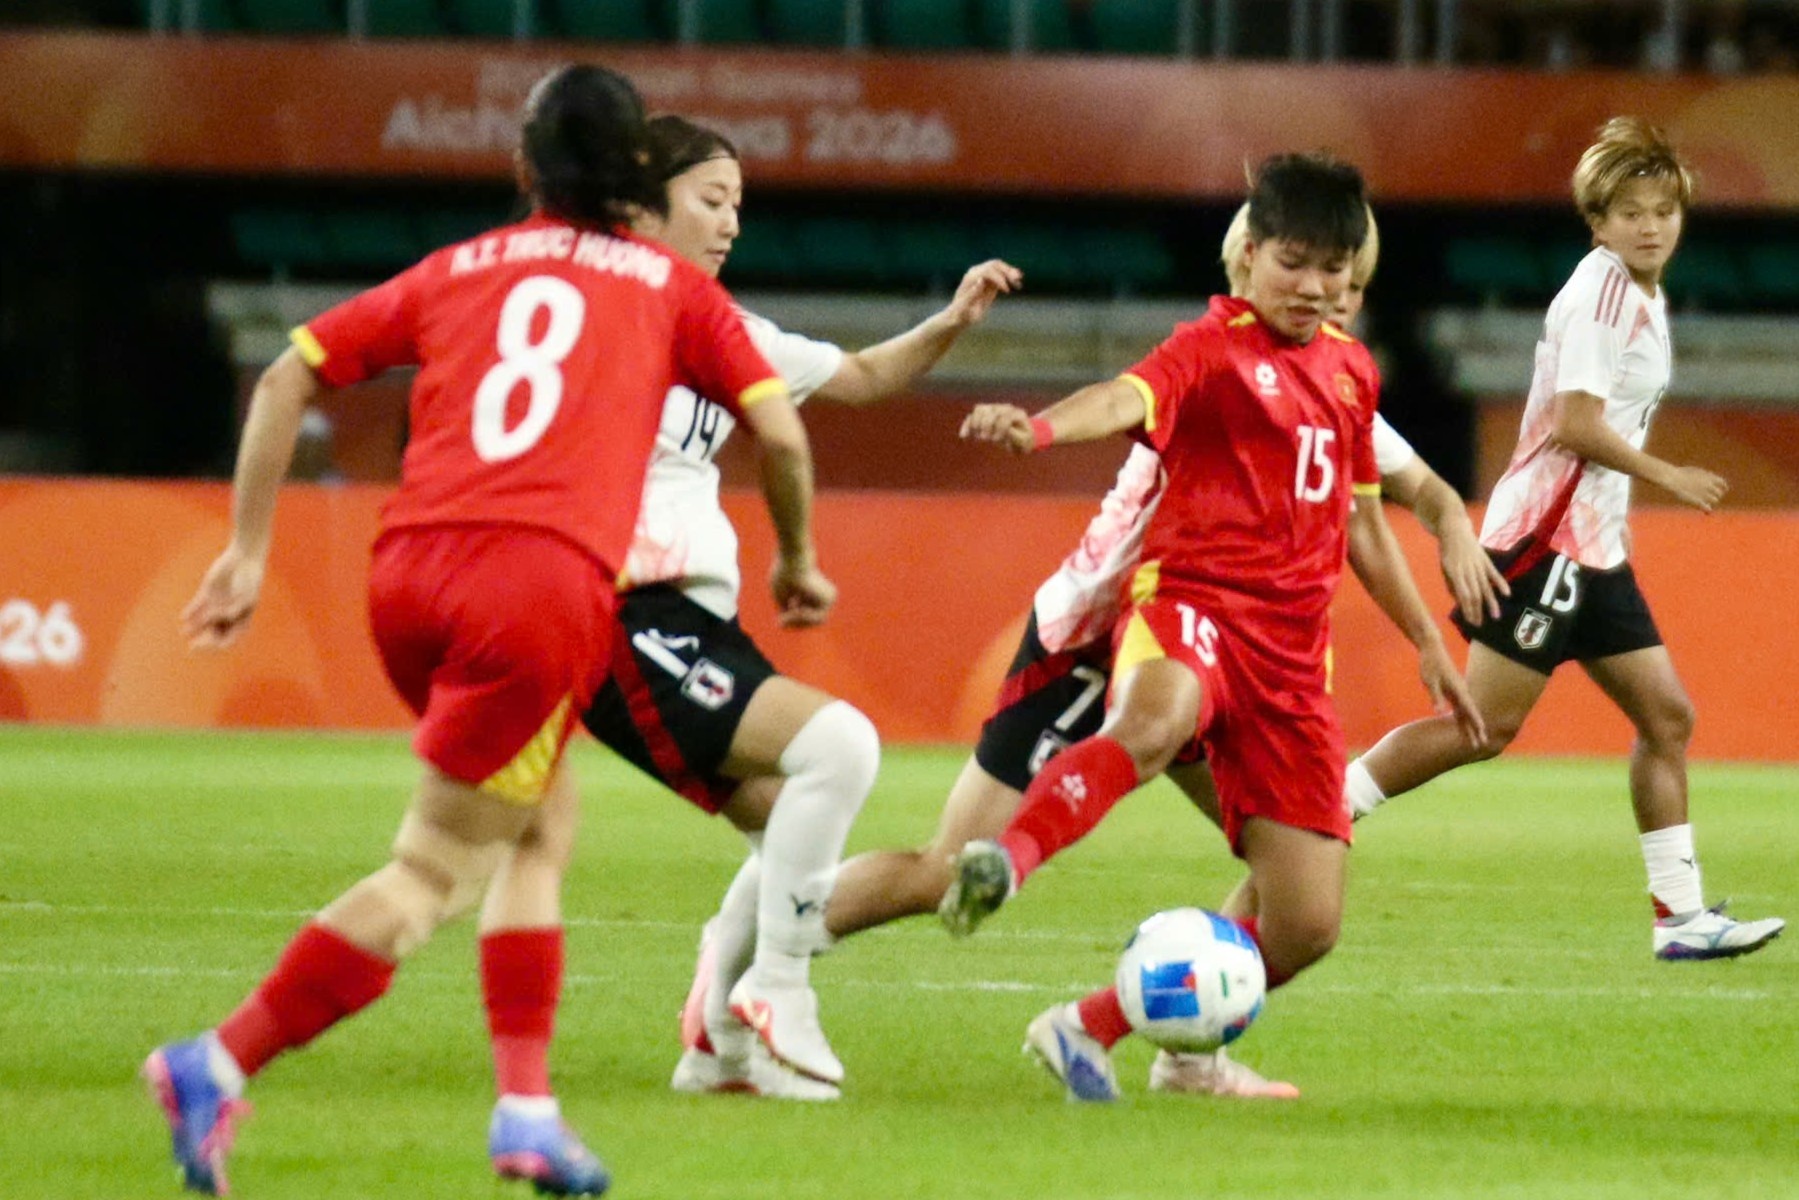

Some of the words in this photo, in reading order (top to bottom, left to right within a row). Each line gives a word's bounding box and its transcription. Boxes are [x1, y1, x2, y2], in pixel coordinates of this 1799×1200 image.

[808, 108, 957, 162] 2026
[471, 275, 586, 464] 8
[681, 393, 720, 461] 14
[1295, 425, 1336, 503] 15
[1541, 554, 1579, 612] 15
[0, 598, 82, 664] 26
[1175, 602, 1219, 668] 15
[1055, 665, 1105, 731] 7
